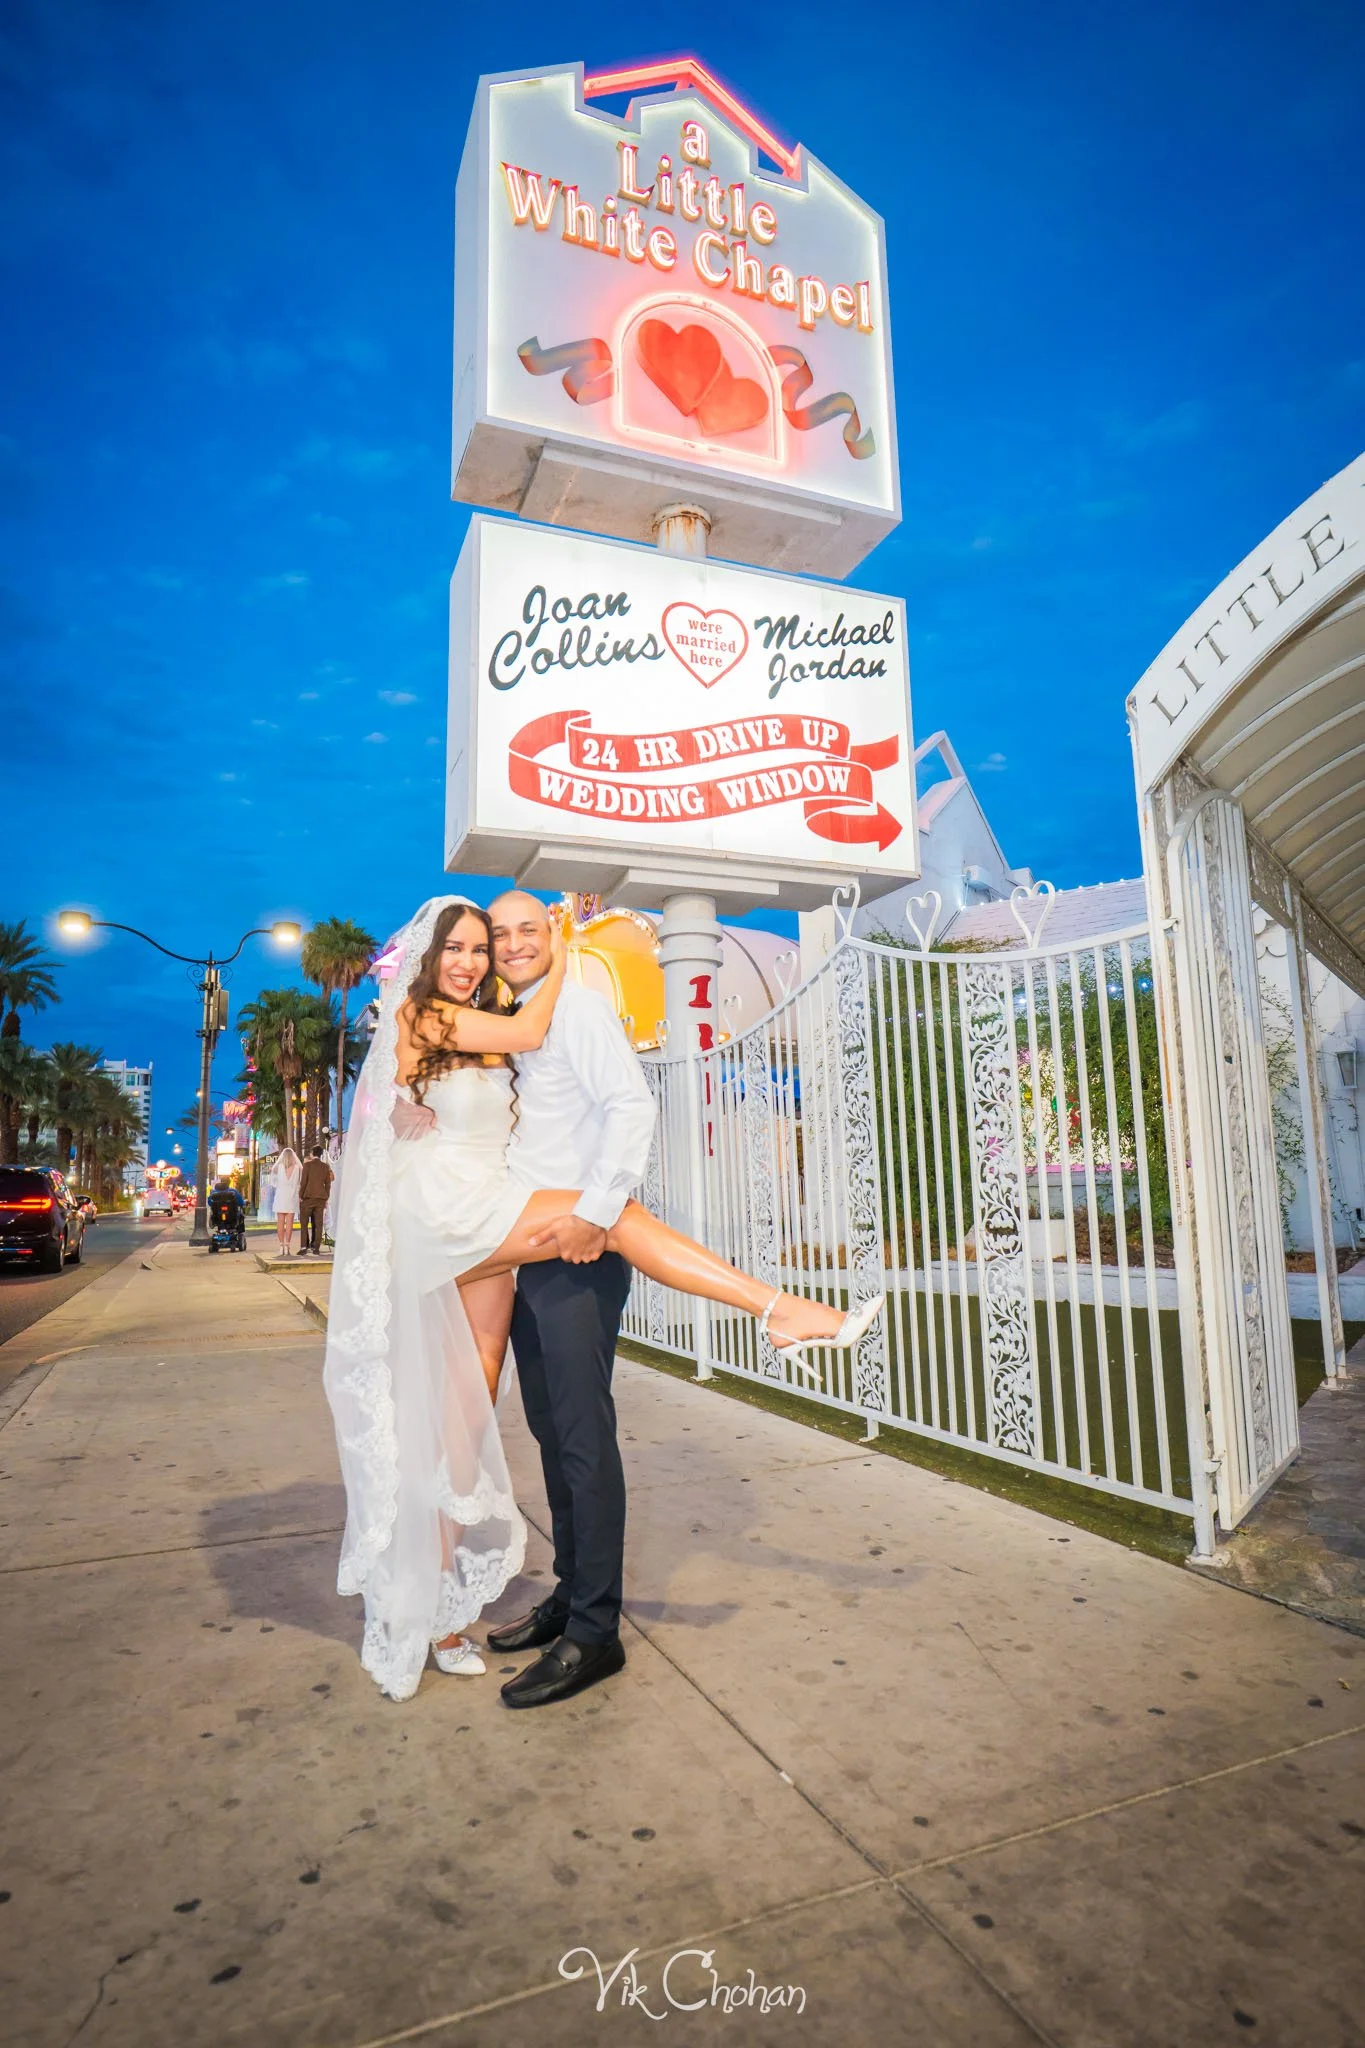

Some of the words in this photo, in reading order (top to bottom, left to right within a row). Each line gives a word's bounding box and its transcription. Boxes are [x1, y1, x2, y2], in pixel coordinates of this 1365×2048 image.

[680, 120, 711, 168] a
[617, 142, 777, 245] Little
[500, 162, 678, 271] White
[692, 230, 874, 333] Chapel
[522, 584, 631, 646] Joan
[688, 618, 723, 634] were
[754, 610, 895, 650] Michael
[1150, 514, 1344, 727] LITTLE
[488, 624, 666, 691] Collins
[676, 632, 737, 653] married
[689, 650, 723, 667] here
[768, 648, 887, 699] Jordan
[582, 738, 620, 771] 24
[634, 737, 683, 767] HR
[692, 717, 787, 759] DRIVE
[803, 721, 840, 750] UP
[537, 767, 705, 818] WEDDING
[719, 766, 851, 809] WINDOW
